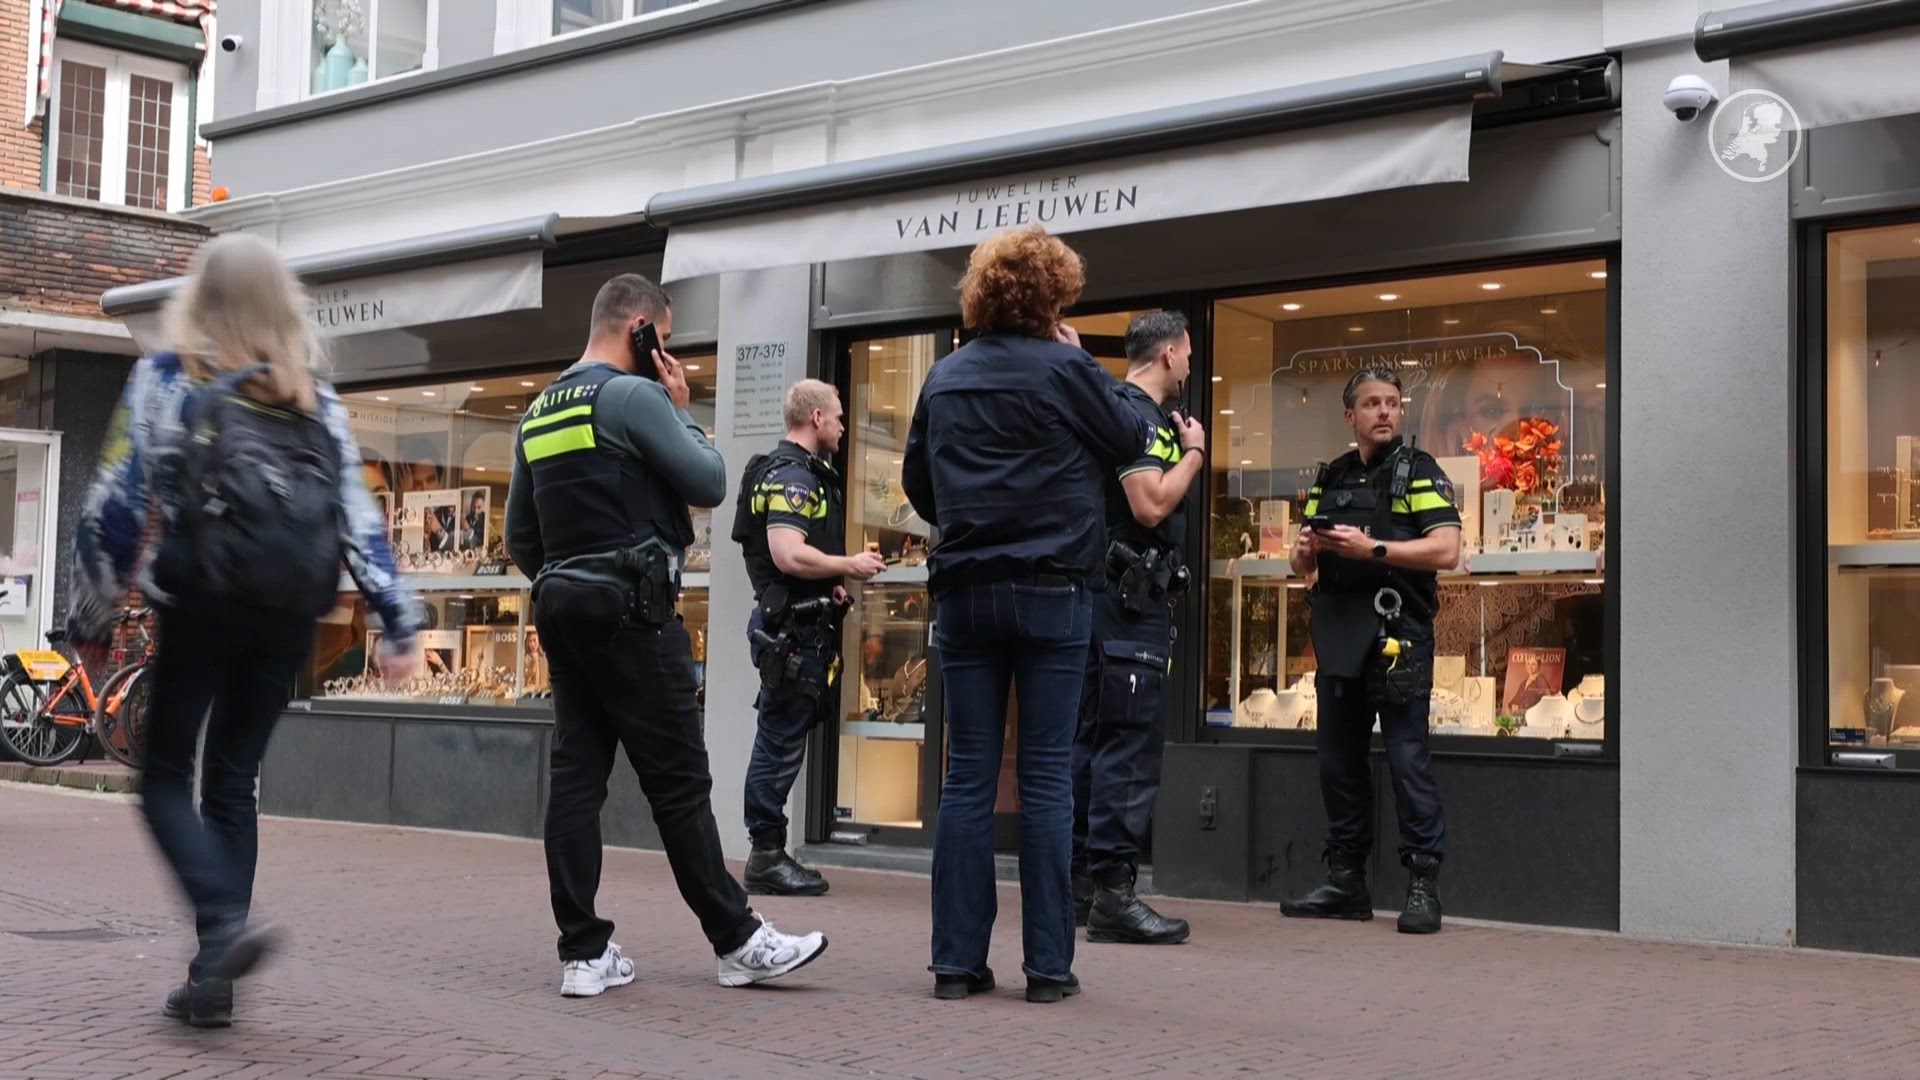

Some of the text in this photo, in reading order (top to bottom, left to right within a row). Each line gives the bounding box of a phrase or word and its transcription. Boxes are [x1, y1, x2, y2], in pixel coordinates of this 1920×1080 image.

[955, 175, 1078, 205] JUWELIER
[896, 185, 1138, 241] VAN LEEUWEN
[317, 289, 349, 304] LIER
[316, 299, 384, 327] EUWEN
[737, 342, 785, 361] 377-379
[477, 565, 500, 574] BOSS
[495, 633, 517, 642] BOSS
[438, 696, 461, 704] BOSS
